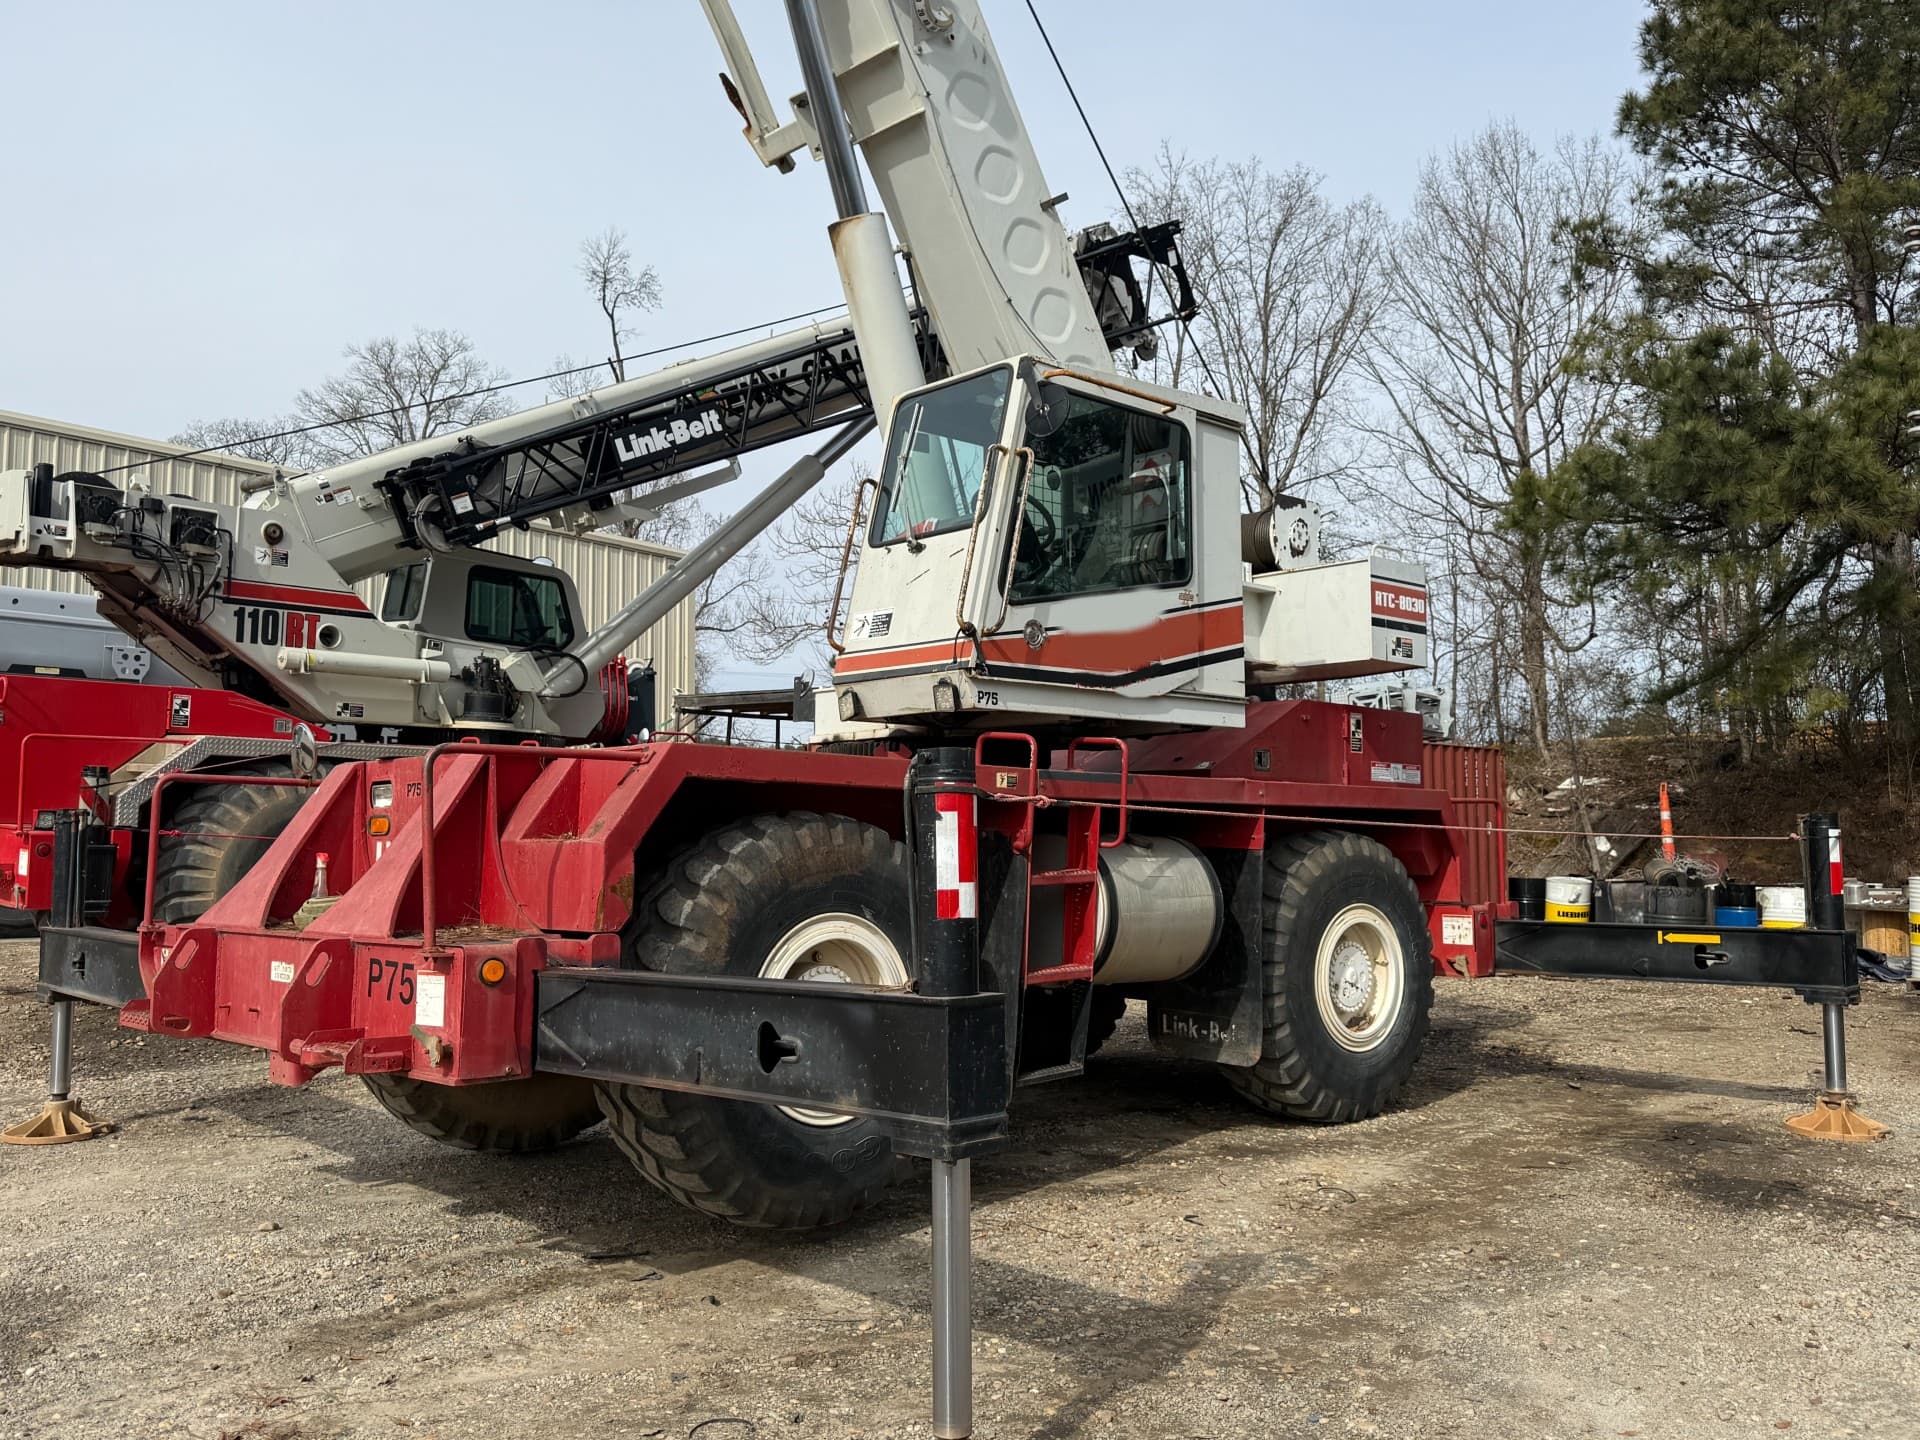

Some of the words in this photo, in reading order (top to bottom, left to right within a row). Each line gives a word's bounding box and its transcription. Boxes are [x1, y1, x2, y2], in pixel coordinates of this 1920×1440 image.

[614, 409, 723, 462] Link-Belt
[1374, 589, 1425, 614] RTC-8030
[233, 606, 280, 646] 110
[285, 611, 321, 650] RT
[977, 690, 998, 705] P75
[406, 783, 422, 797] P75
[367, 957, 415, 1005] P75
